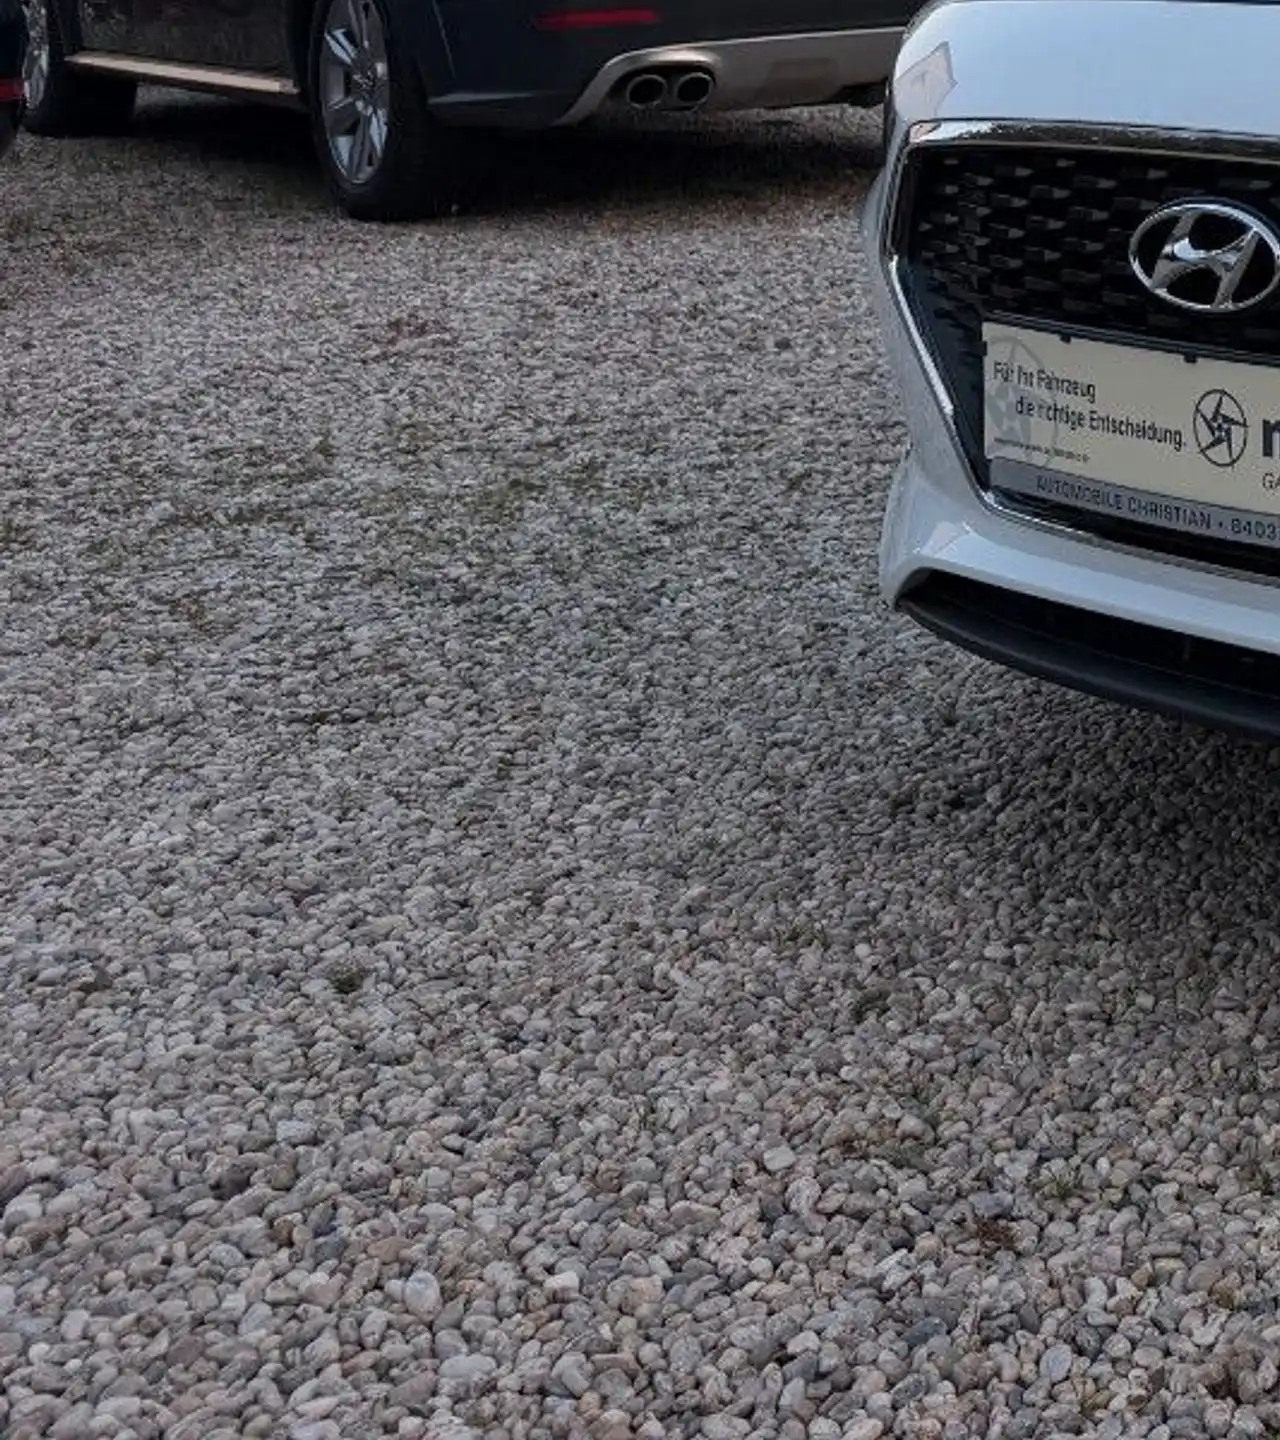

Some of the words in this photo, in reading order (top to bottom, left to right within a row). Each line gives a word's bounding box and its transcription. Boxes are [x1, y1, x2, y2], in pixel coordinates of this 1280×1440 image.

[1036, 369, 1096, 404] Fahrzeug
[1037, 475, 1123, 511] AUTOMOBILE
[1127, 494, 1212, 531] CHRISTIAN
